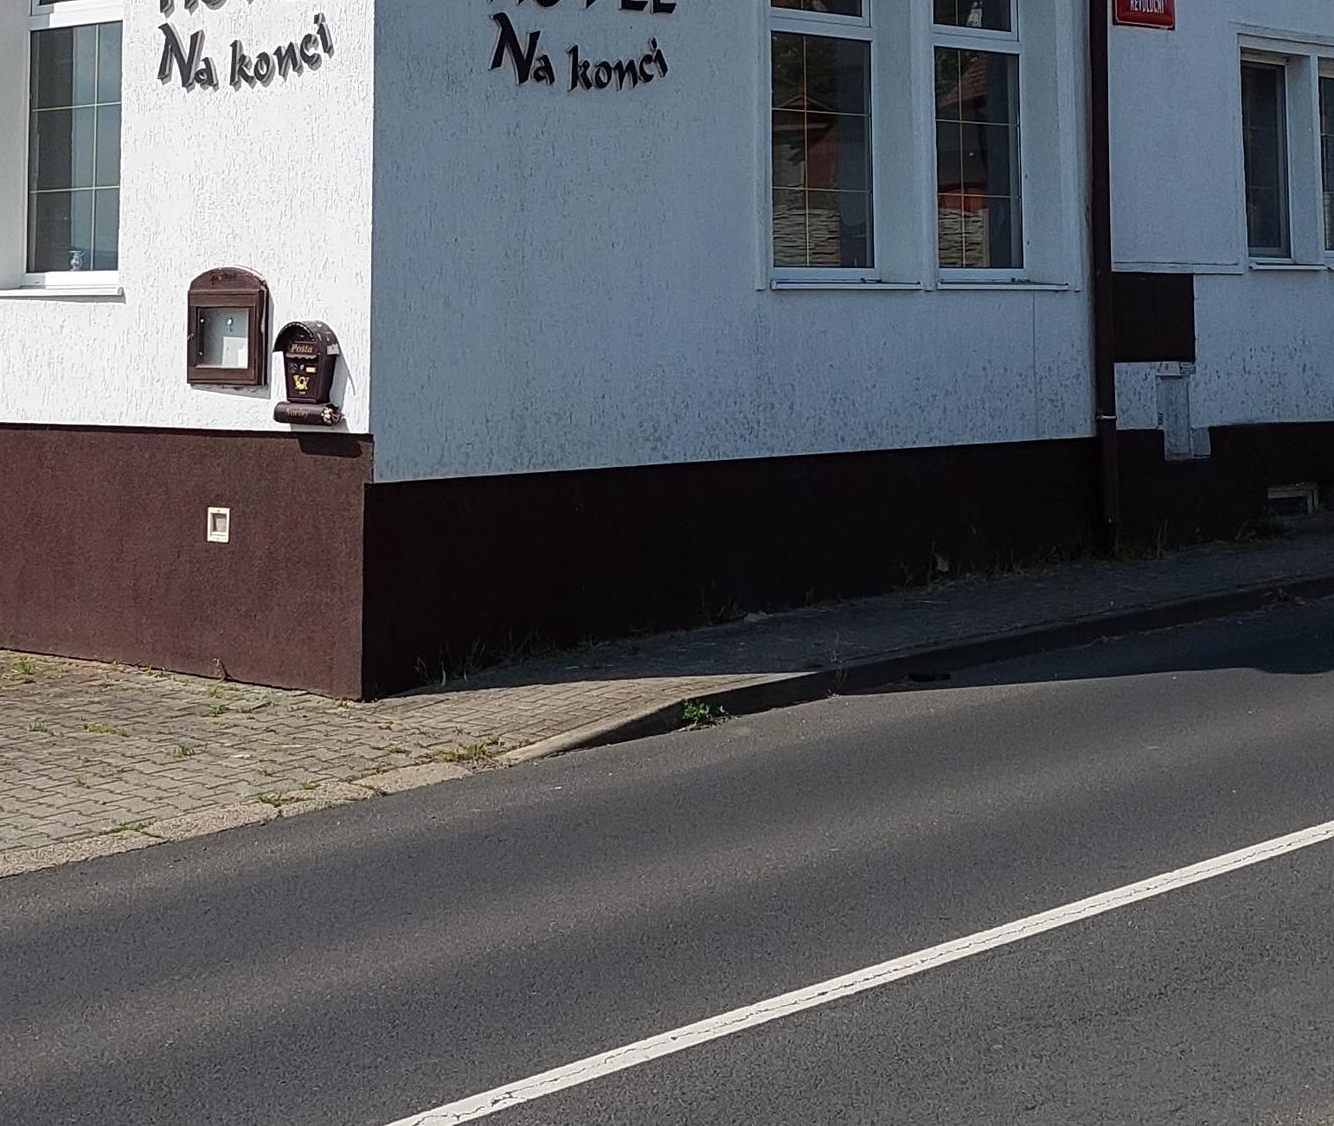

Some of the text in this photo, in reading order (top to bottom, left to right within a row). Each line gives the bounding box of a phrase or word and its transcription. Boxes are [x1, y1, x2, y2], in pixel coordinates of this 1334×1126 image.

[157, 12, 335, 93] Na konci
[489, 11, 669, 92] Na konci
